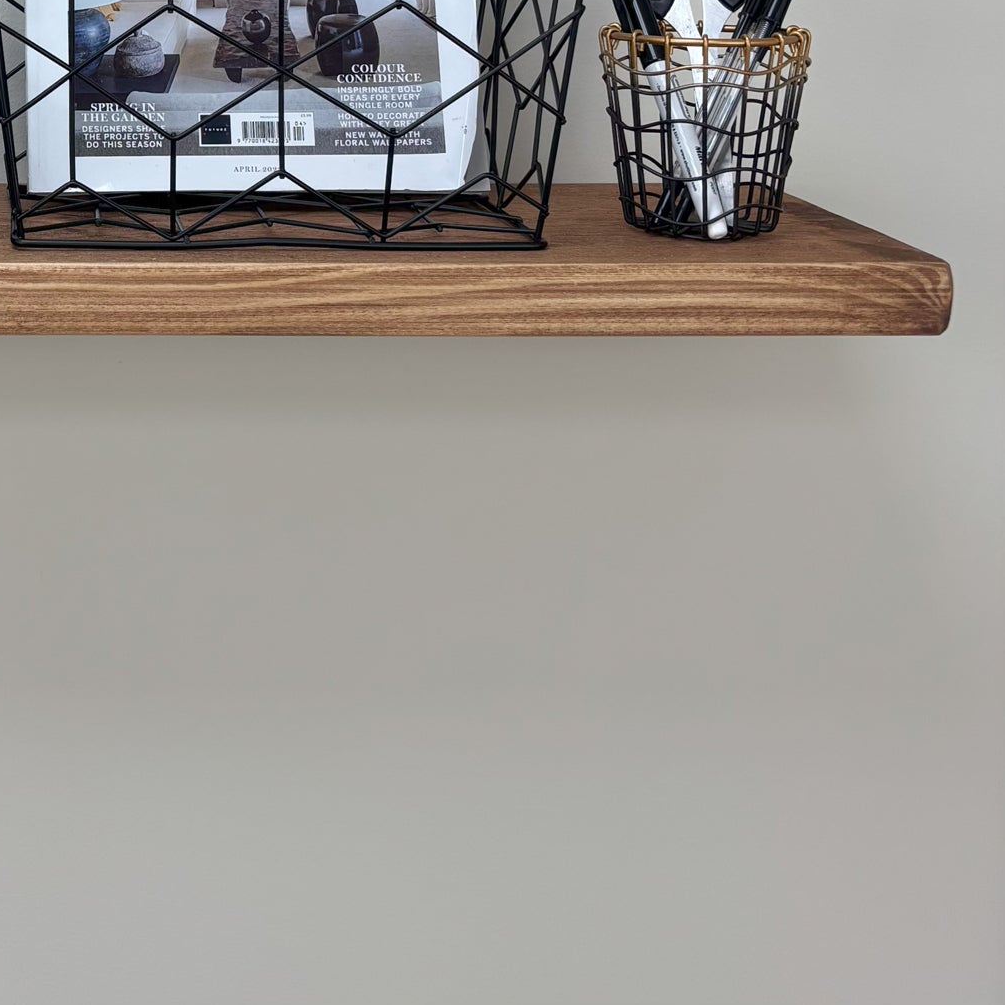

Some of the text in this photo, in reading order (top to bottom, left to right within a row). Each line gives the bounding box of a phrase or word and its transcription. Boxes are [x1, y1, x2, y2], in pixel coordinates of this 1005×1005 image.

[351, 63, 406, 73] COLOUR
[336, 73, 422, 83] CONFIDENCE
[397, 85, 423, 93] BOLD
[391, 93, 421, 101] EVERY
[90, 102, 155, 112] SPRIG IN
[81, 113, 109, 122] THE
[83, 133, 101, 141] THE
[372, 138, 433, 146] WALPAPERS
